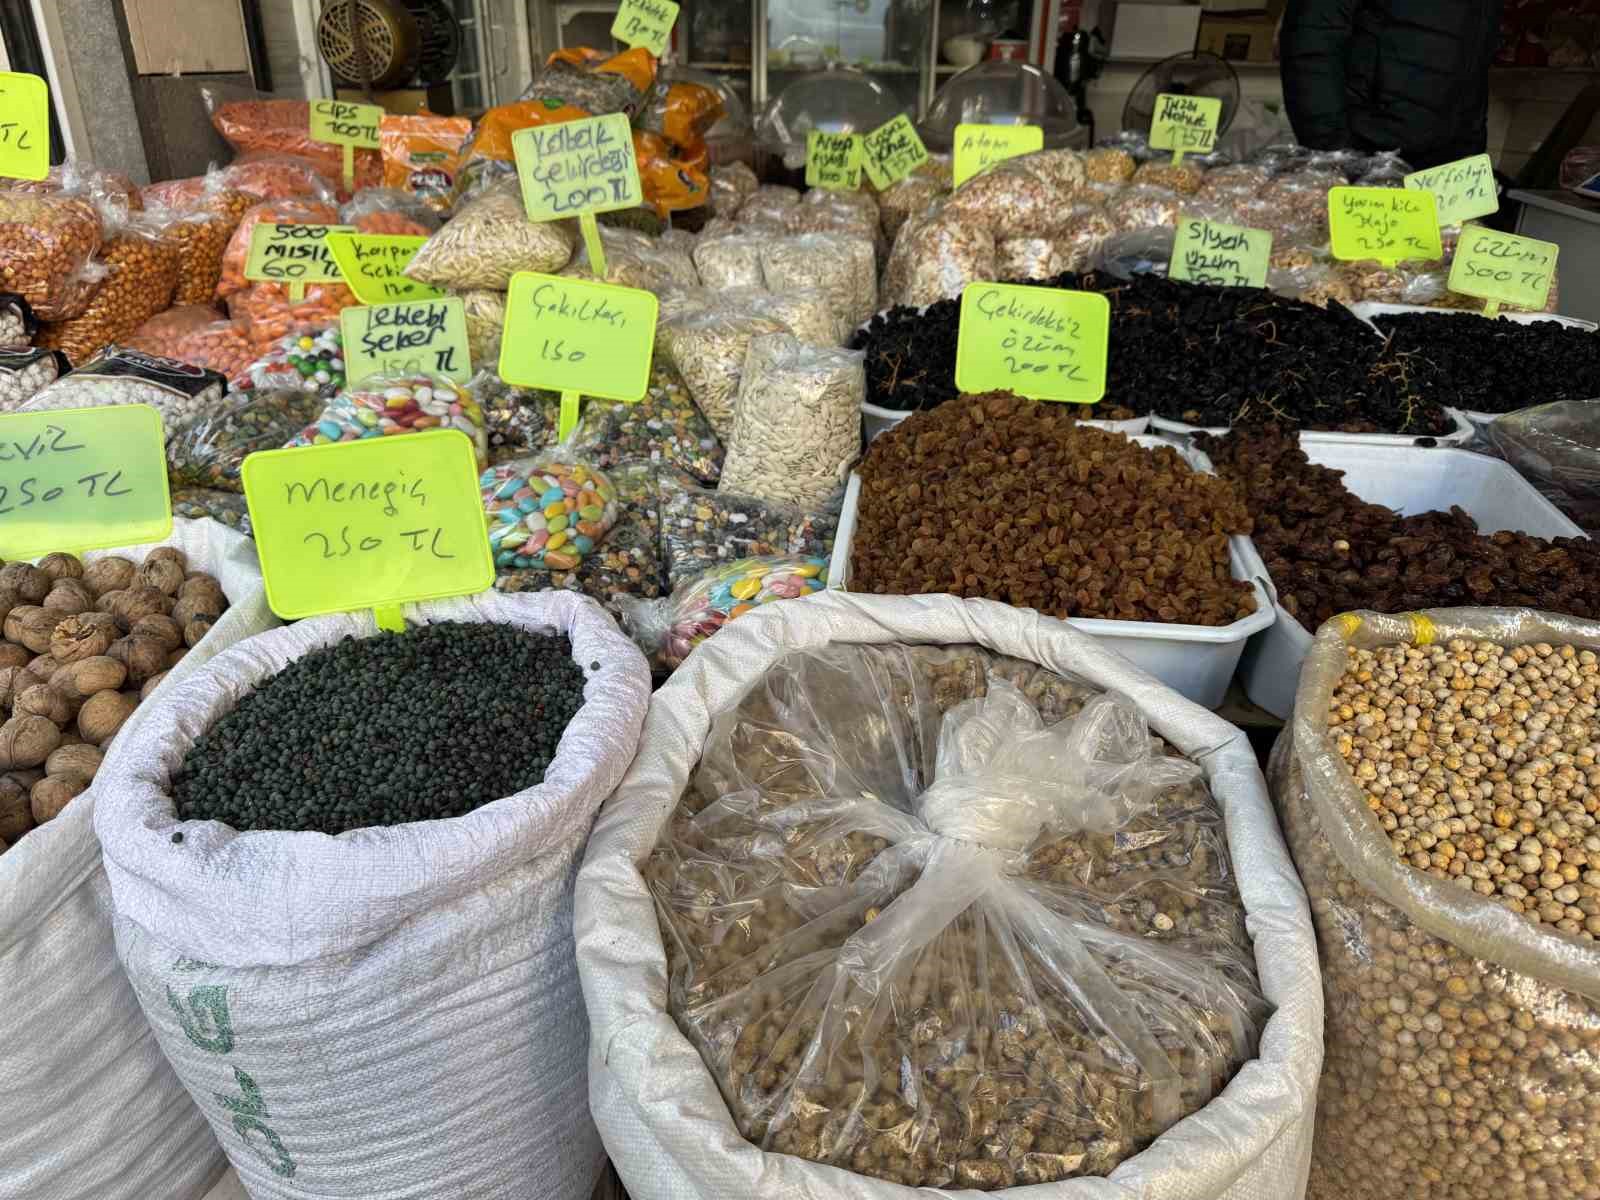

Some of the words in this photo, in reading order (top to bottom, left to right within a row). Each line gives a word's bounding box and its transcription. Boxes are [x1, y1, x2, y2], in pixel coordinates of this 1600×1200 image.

[271, 224, 329, 240] 500
[261, 258, 307, 278] 60
[1464, 261, 1513, 281] 500
[434, 346, 459, 372] TL
[541, 339, 586, 362] 150
[78, 469, 133, 497] TL
[303, 525, 382, 559] 250
[400, 527, 456, 559] TL
